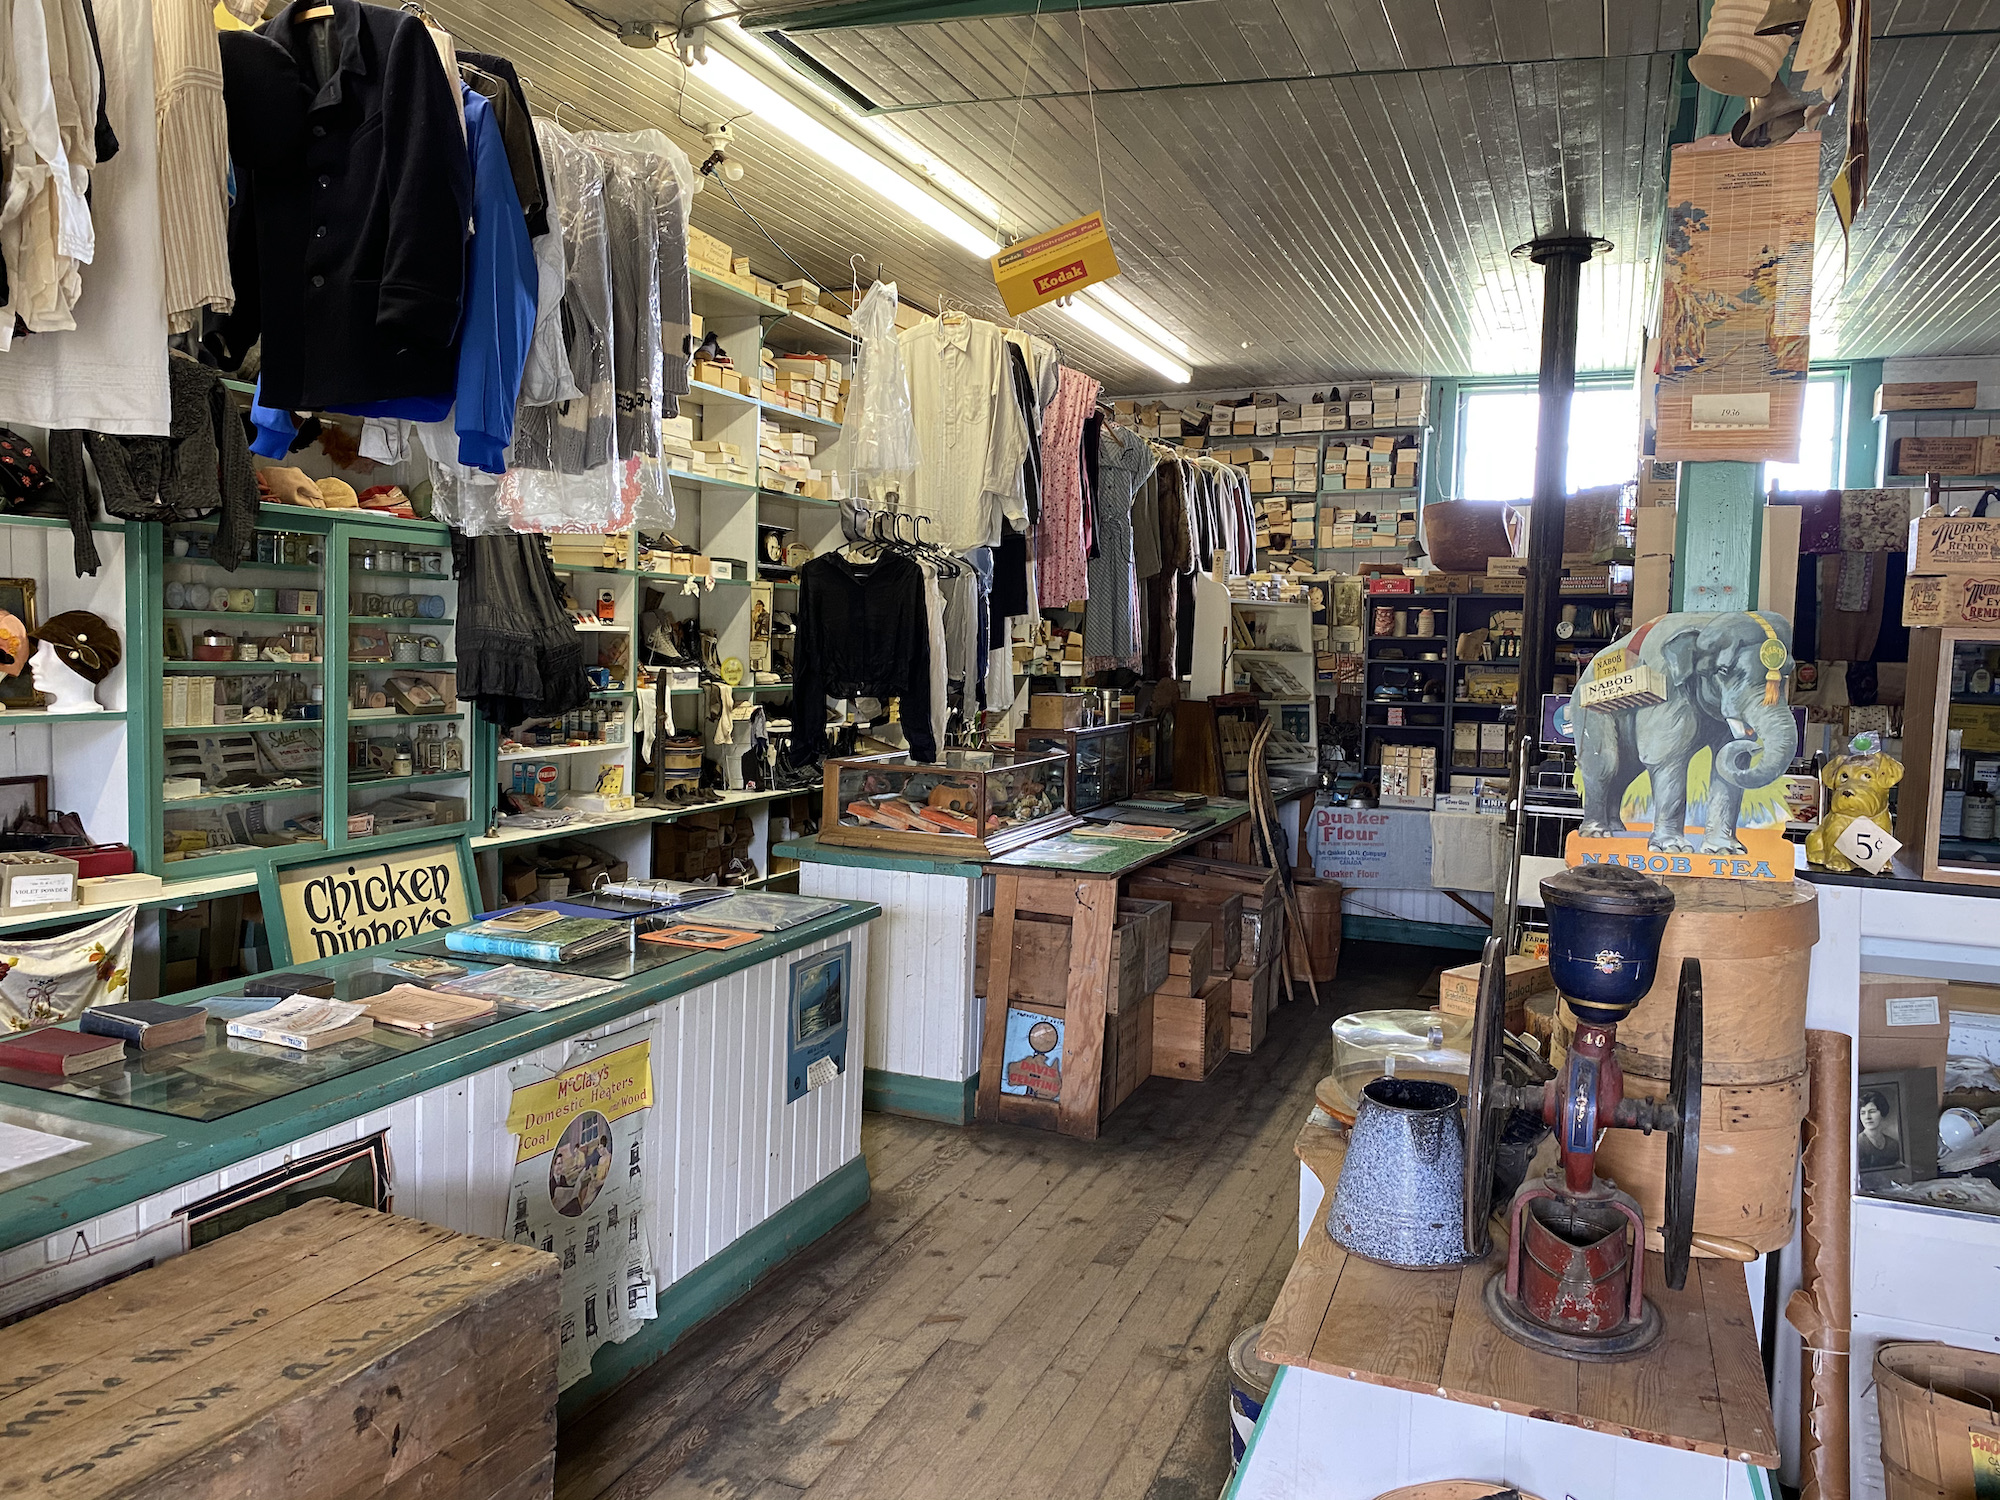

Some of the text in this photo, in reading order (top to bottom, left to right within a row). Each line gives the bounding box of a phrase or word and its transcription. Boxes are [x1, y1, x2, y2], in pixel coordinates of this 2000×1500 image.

[1000, 221, 1098, 265] Kodak Verichrome Pan
[1038, 266, 1083, 291] Kodak
[1721, 408, 1740, 416] 1936
[1930, 522, 1991, 553] MURINE
[1949, 541, 1989, 550] REMEDY
[1597, 654, 1622, 668] NABOB
[1603, 666, 1617, 675] TEA
[1588, 674, 1633, 695] NABOB
[1601, 686, 1624, 696] TEA
[1483, 799, 1507, 807] LINIT
[1316, 810, 1389, 827] Quaker
[1323, 826, 1378, 841] Flour
[1855, 833, 1883, 861] 5¢
[1323, 869, 1380, 878] Quaker Flour
[1581, 853, 1776, 878] NABOB TEA
[304, 863, 450, 929] Chicken
[1582, 1032, 1606, 1048] 40
[1020, 1060, 1058, 1078] DAVIS
[557, 1063, 610, 1100] McClay's
[1010, 1073, 1059, 1093] GELATINE
[525, 1076, 634, 1130] Domestic Heaters
[523, 1129, 550, 1150] Coal
[621, 1089, 647, 1108] Wood
[130, 1308, 270, 1363] House
